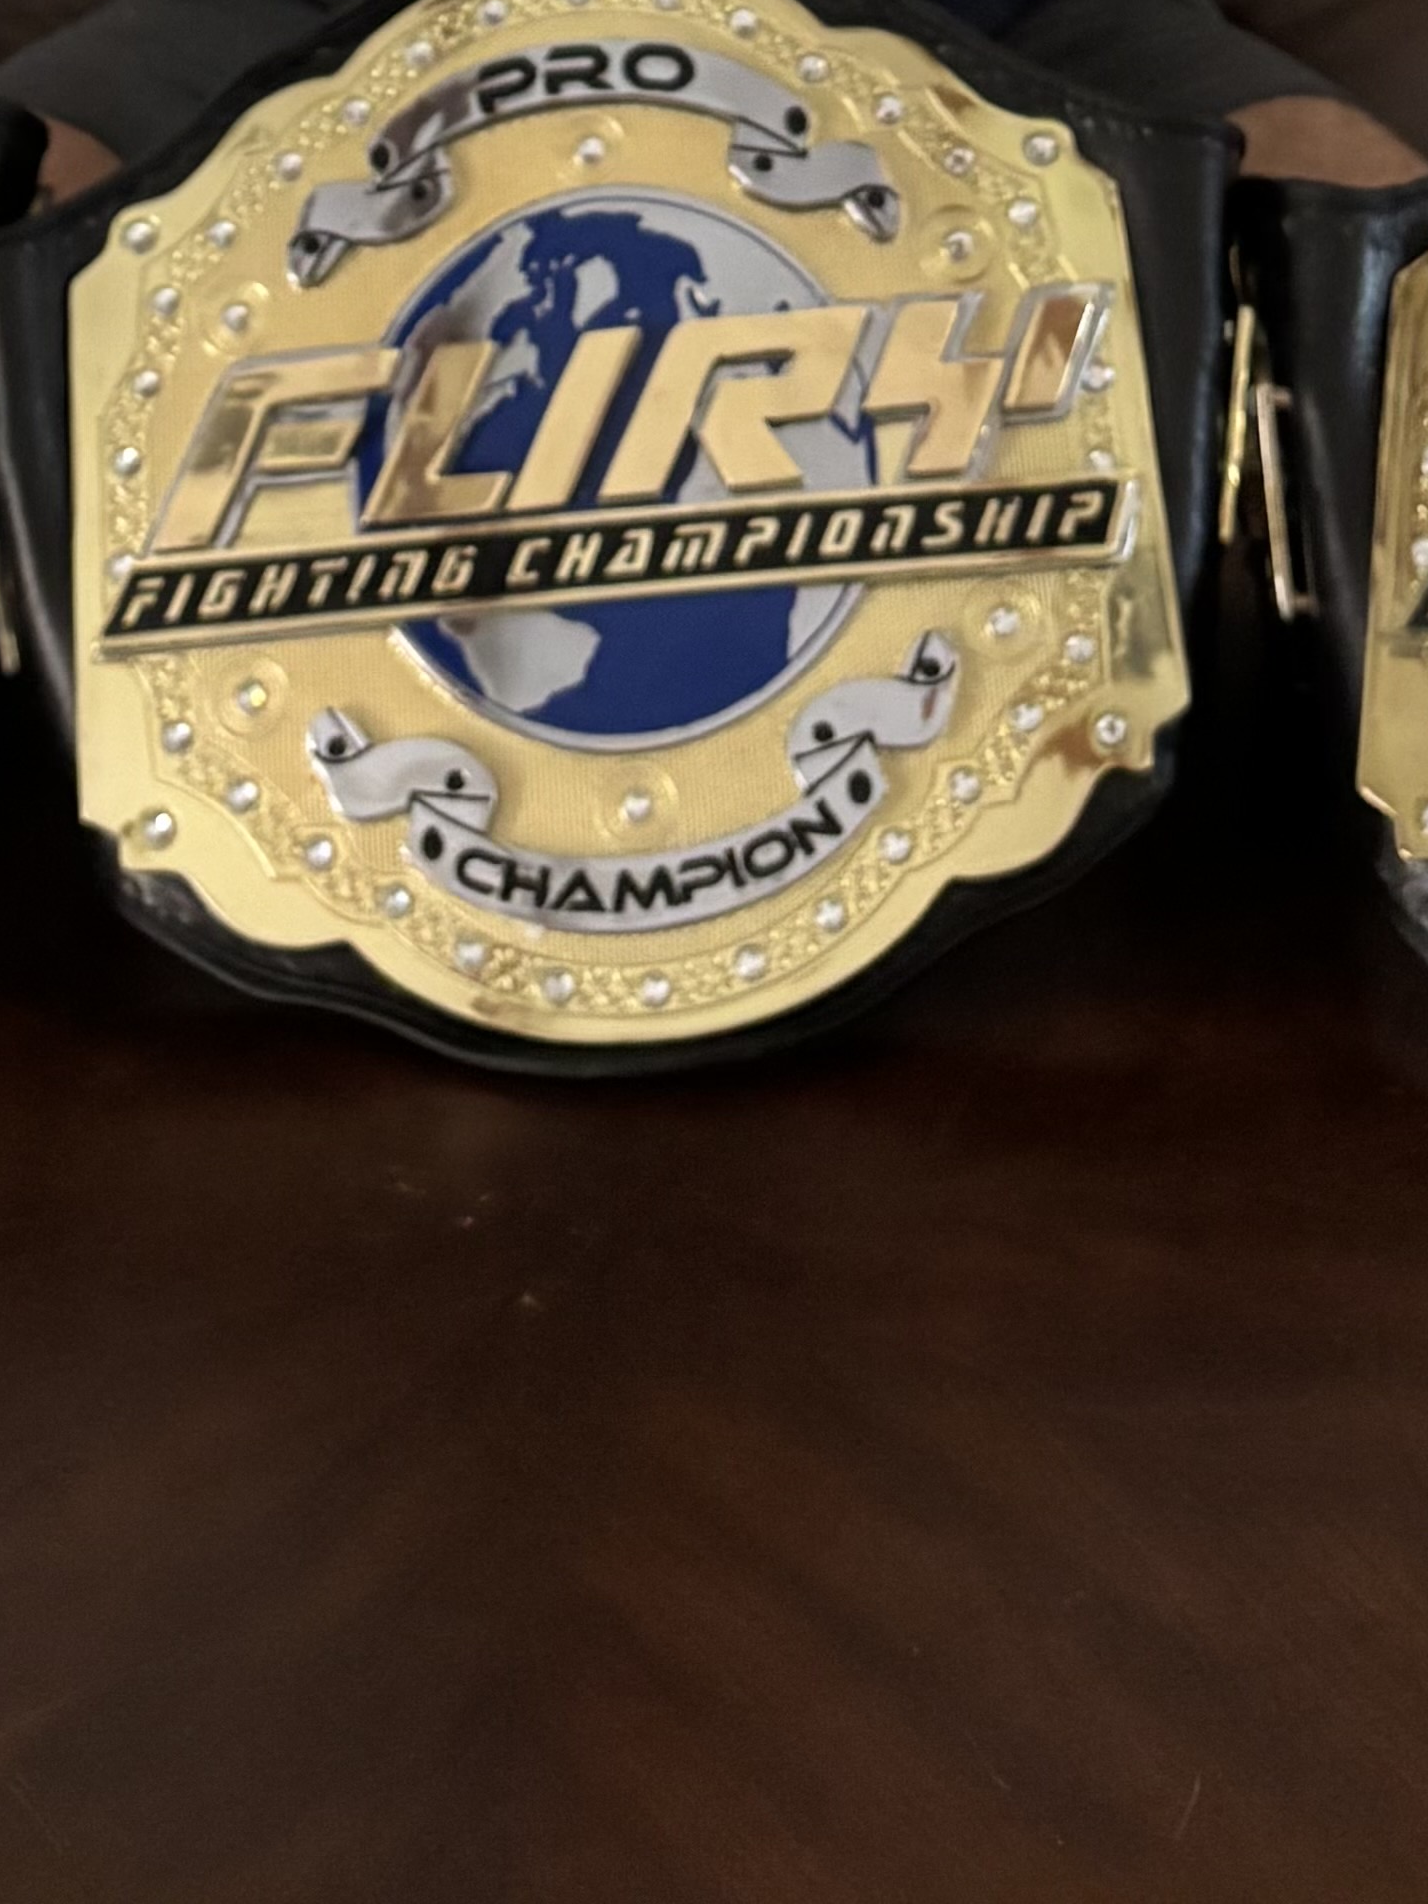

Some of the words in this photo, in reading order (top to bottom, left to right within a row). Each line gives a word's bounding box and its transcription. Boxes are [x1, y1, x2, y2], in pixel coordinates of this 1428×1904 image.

[474, 42, 696, 113] PRO
[153, 282, 1115, 554] FURY
[122, 544, 476, 630] FIGHTING
[506, 502, 1103, 588] CHAMPIONSHIP
[454, 805, 843, 913] CHAMPION
